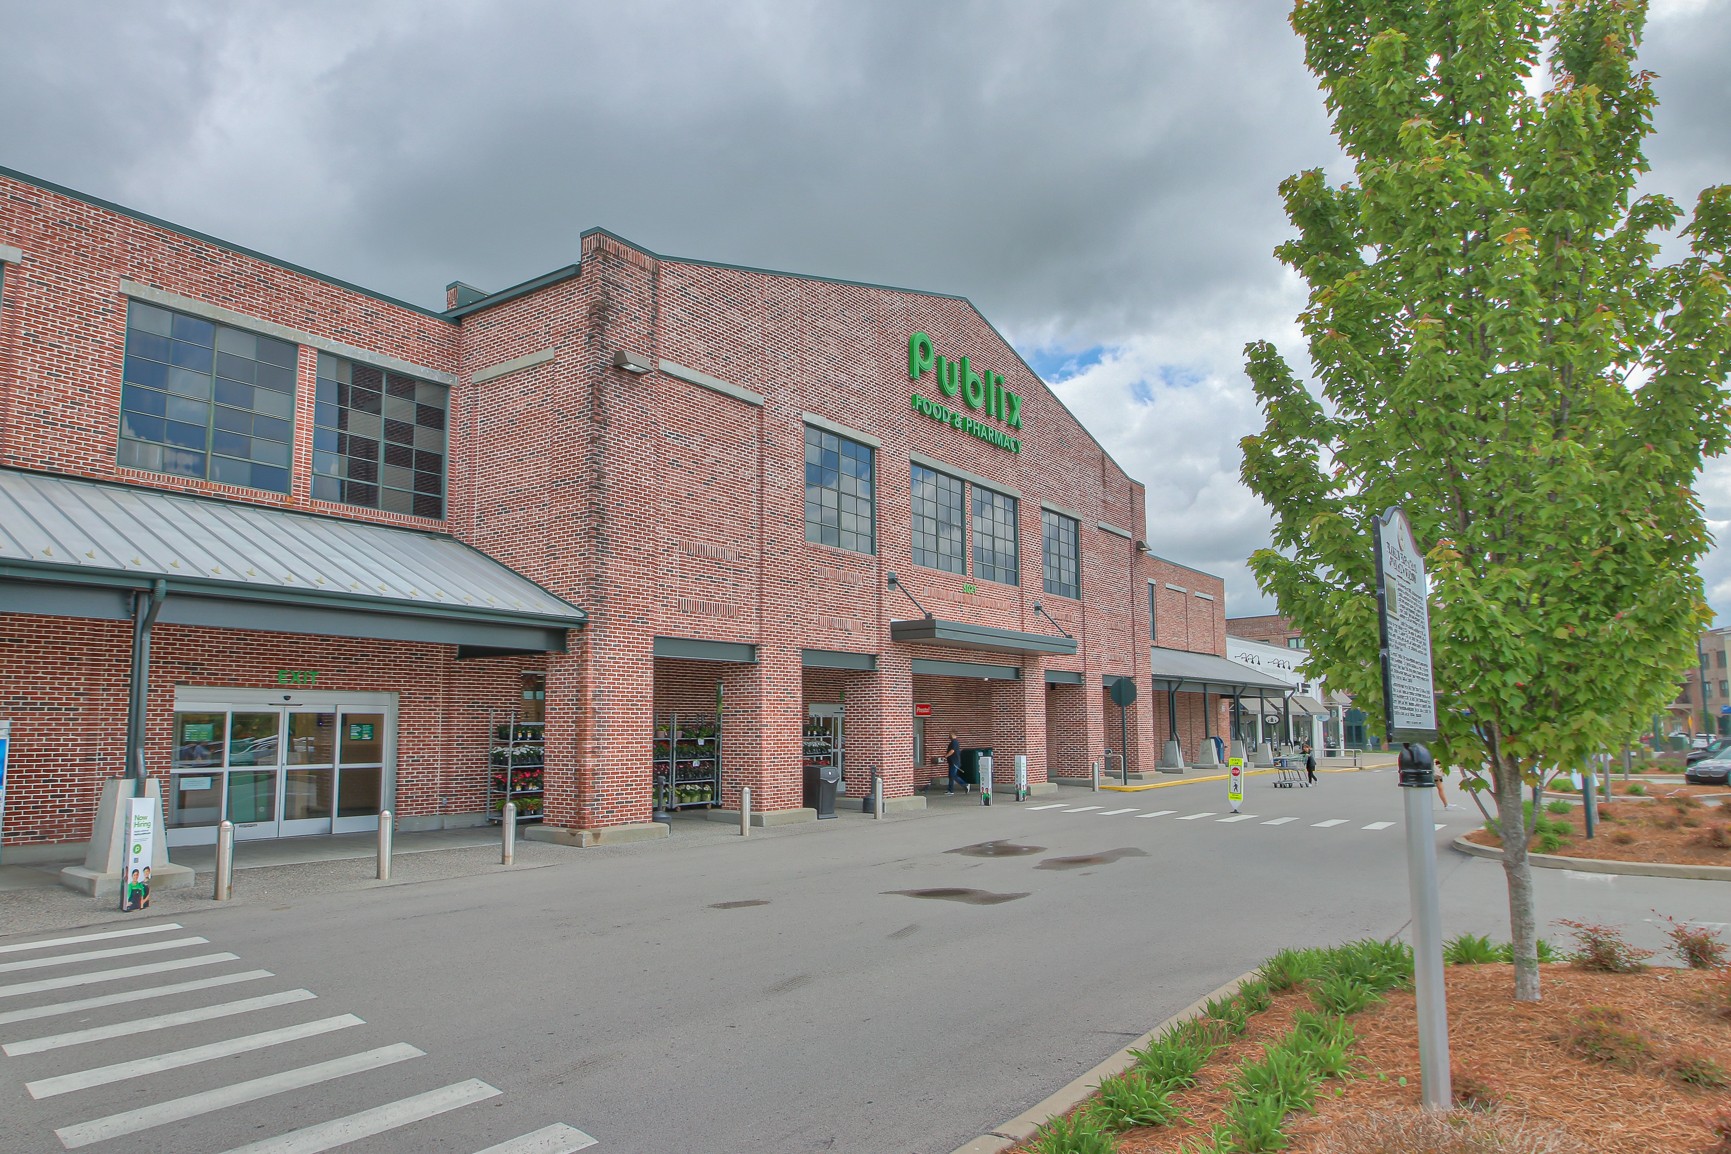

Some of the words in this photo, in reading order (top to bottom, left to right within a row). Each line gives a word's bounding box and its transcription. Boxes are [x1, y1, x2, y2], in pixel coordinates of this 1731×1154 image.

[909, 331, 1024, 430] Publix
[911, 393, 951, 424] FOOD
[950, 411, 963, 431] &
[962, 416, 1024, 454] PHARMACY
[278, 669, 319, 685] EXIT
[134, 821, 151, 829] Hiring
